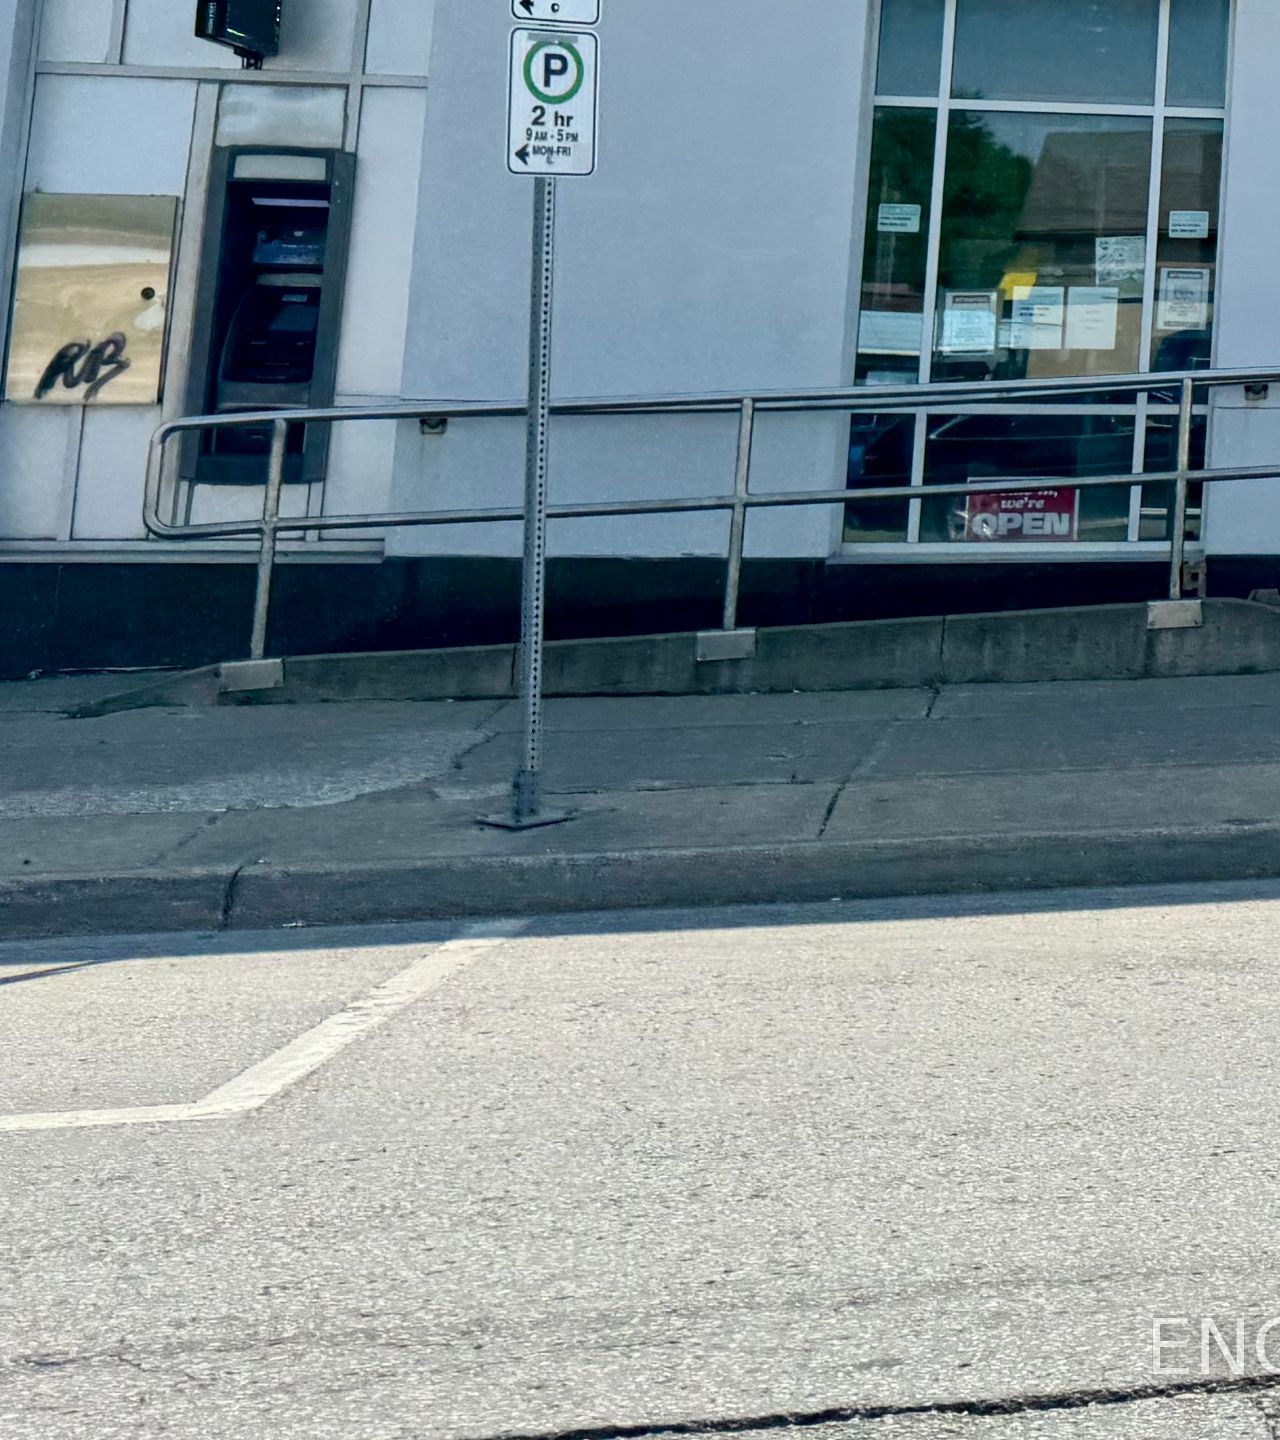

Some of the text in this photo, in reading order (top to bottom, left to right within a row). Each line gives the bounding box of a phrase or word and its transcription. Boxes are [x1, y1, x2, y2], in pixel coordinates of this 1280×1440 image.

[544, 53, 568, 87] P
[531, 105, 574, 127] 2 hr
[532, 145, 571, 157] MON-FRI
[971, 512, 1070, 536] OPEN
